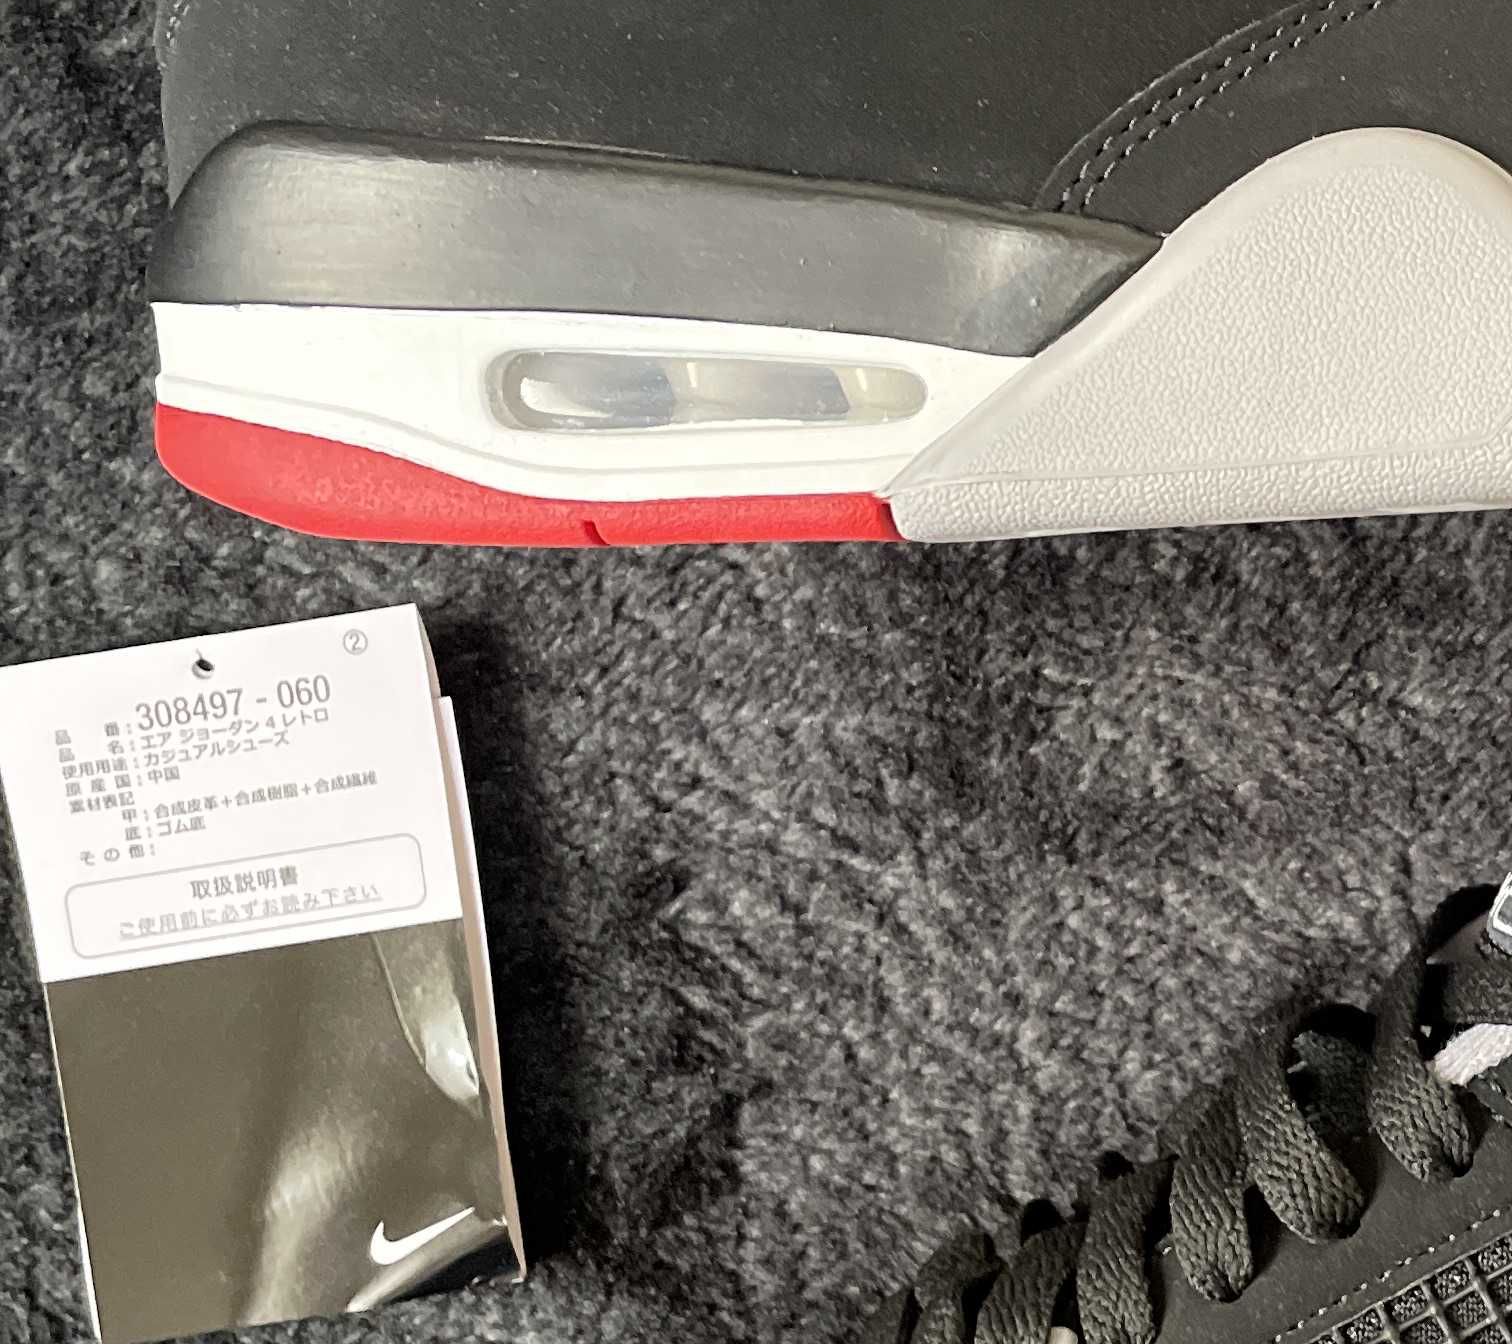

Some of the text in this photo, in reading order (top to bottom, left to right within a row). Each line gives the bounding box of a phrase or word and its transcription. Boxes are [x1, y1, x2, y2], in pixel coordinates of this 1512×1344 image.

[135, 688, 243, 731] 308497
[277, 675, 330, 709] 060
[189, 865, 298, 900] 取扱説明書
